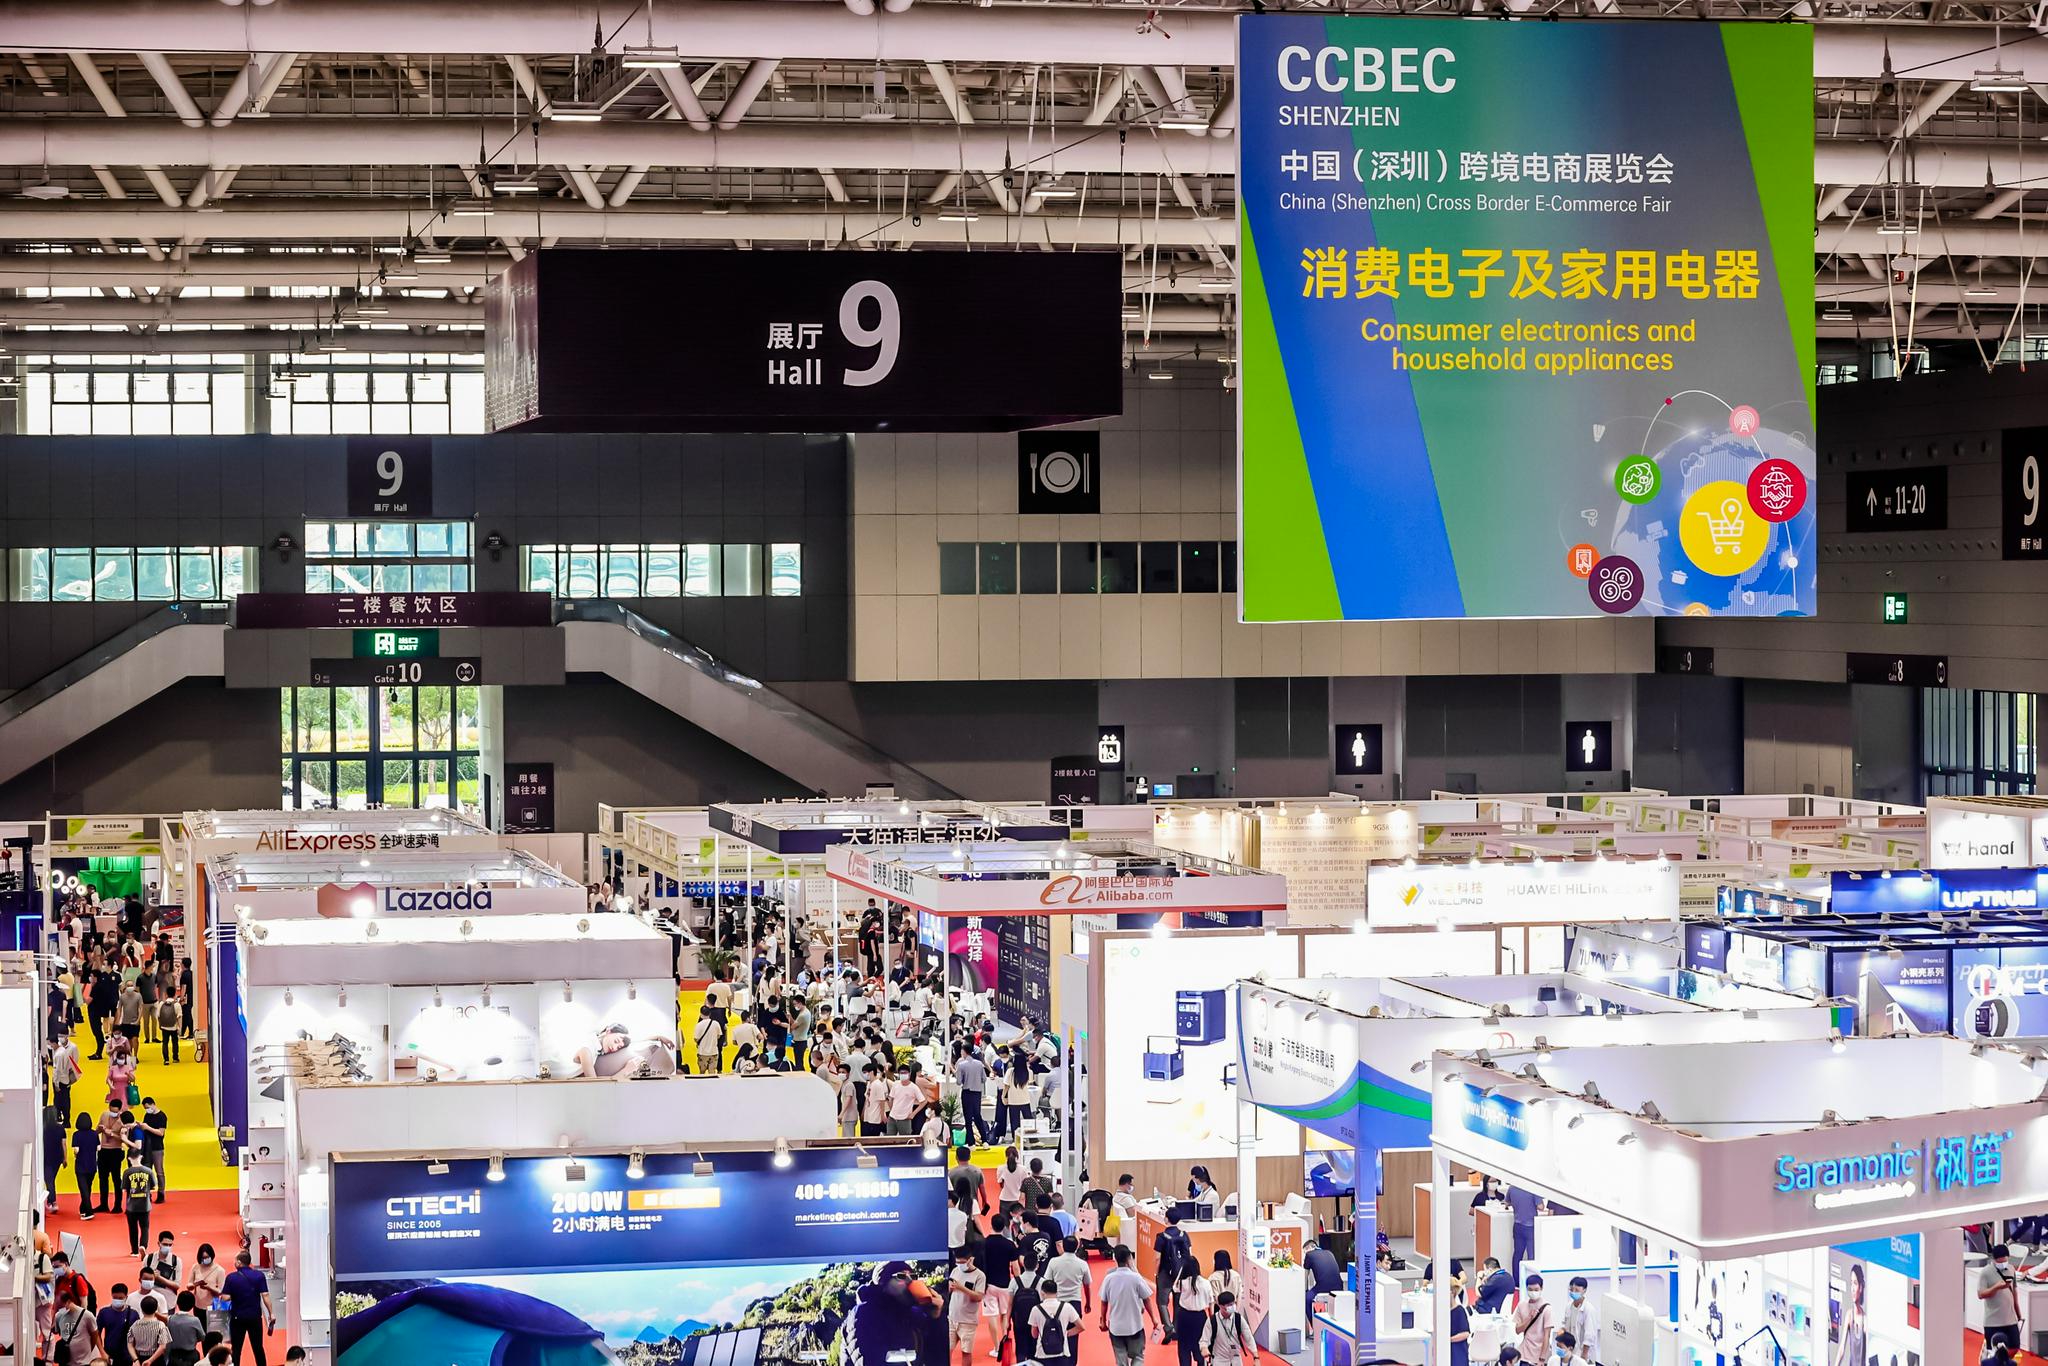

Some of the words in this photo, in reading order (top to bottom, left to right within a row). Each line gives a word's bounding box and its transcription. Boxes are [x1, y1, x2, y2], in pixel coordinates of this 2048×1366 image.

[1277, 45, 1456, 93] CCBEC
[1279, 106, 1400, 127] SHENZHEN
[1280, 150, 1674, 184] 中国（深圳）跨境电商展览会
[1280, 193, 1326, 210] China
[1331, 192, 1421, 213] (Shenzhen)
[1426, 194, 1471, 211] Cross
[1477, 194, 1530, 212] Border
[1535, 196, 1637, 213] E-Commerce
[1643, 196, 1672, 213] Fair
[1300, 246, 1760, 300] 消费电子及家用电器
[767, 323, 823, 350] 展厅
[838, 280, 901, 387] 9
[1361, 318, 1492, 342] Consumer
[1500, 319, 1640, 343] electronics
[1647, 319, 1696, 343] and
[768, 360, 822, 385] Hall
[1392, 348, 1526, 371] household
[1535, 349, 1674, 375] appliances
[376, 451, 404, 497] 9
[1896, 484, 1926, 514] 11-20
[2022, 455, 2039, 526] 9
[393, 503, 408, 512] Hall
[338, 596, 457, 614] 二楼餐饮区
[386, 617, 424, 625] Dining
[374, 675, 395, 683] Gate
[399, 662, 422, 683] 10
[1897, 660, 1904, 682] 8
[518, 773, 538, 783] 用餐
[510, 786, 547, 795] 请往2楼
[256, 830, 376, 853] AliExpress
[379, 833, 440, 850] 全球速卖通
[1085, 875, 1174, 889] 阿里巴巴国际站
[1507, 884, 1561, 896] HUAWEI
[1566, 883, 1607, 896] HiLink
[385, 887, 492, 912] Lazada
[1096, 890, 1173, 902] Alibaba.com
[967, 915, 983, 962] 新选择
[1775, 1142, 1915, 1192] Saramonic
[1935, 1132, 2003, 1191] 枫笛
[552, 1191, 623, 1213] 2000W
[387, 1221, 416, 1230] SINCE
[418, 1220, 441, 1229] 2005
[552, 1215, 626, 1233] 2小时满电
[795, 1211, 899, 1222] marketing@ctechi.com.cn
[1890, 1236, 1912, 1256] BOYA
[1364, 1254, 1372, 1277] JIMMY
[1364, 1279, 1372, 1314] ELEPHANT
